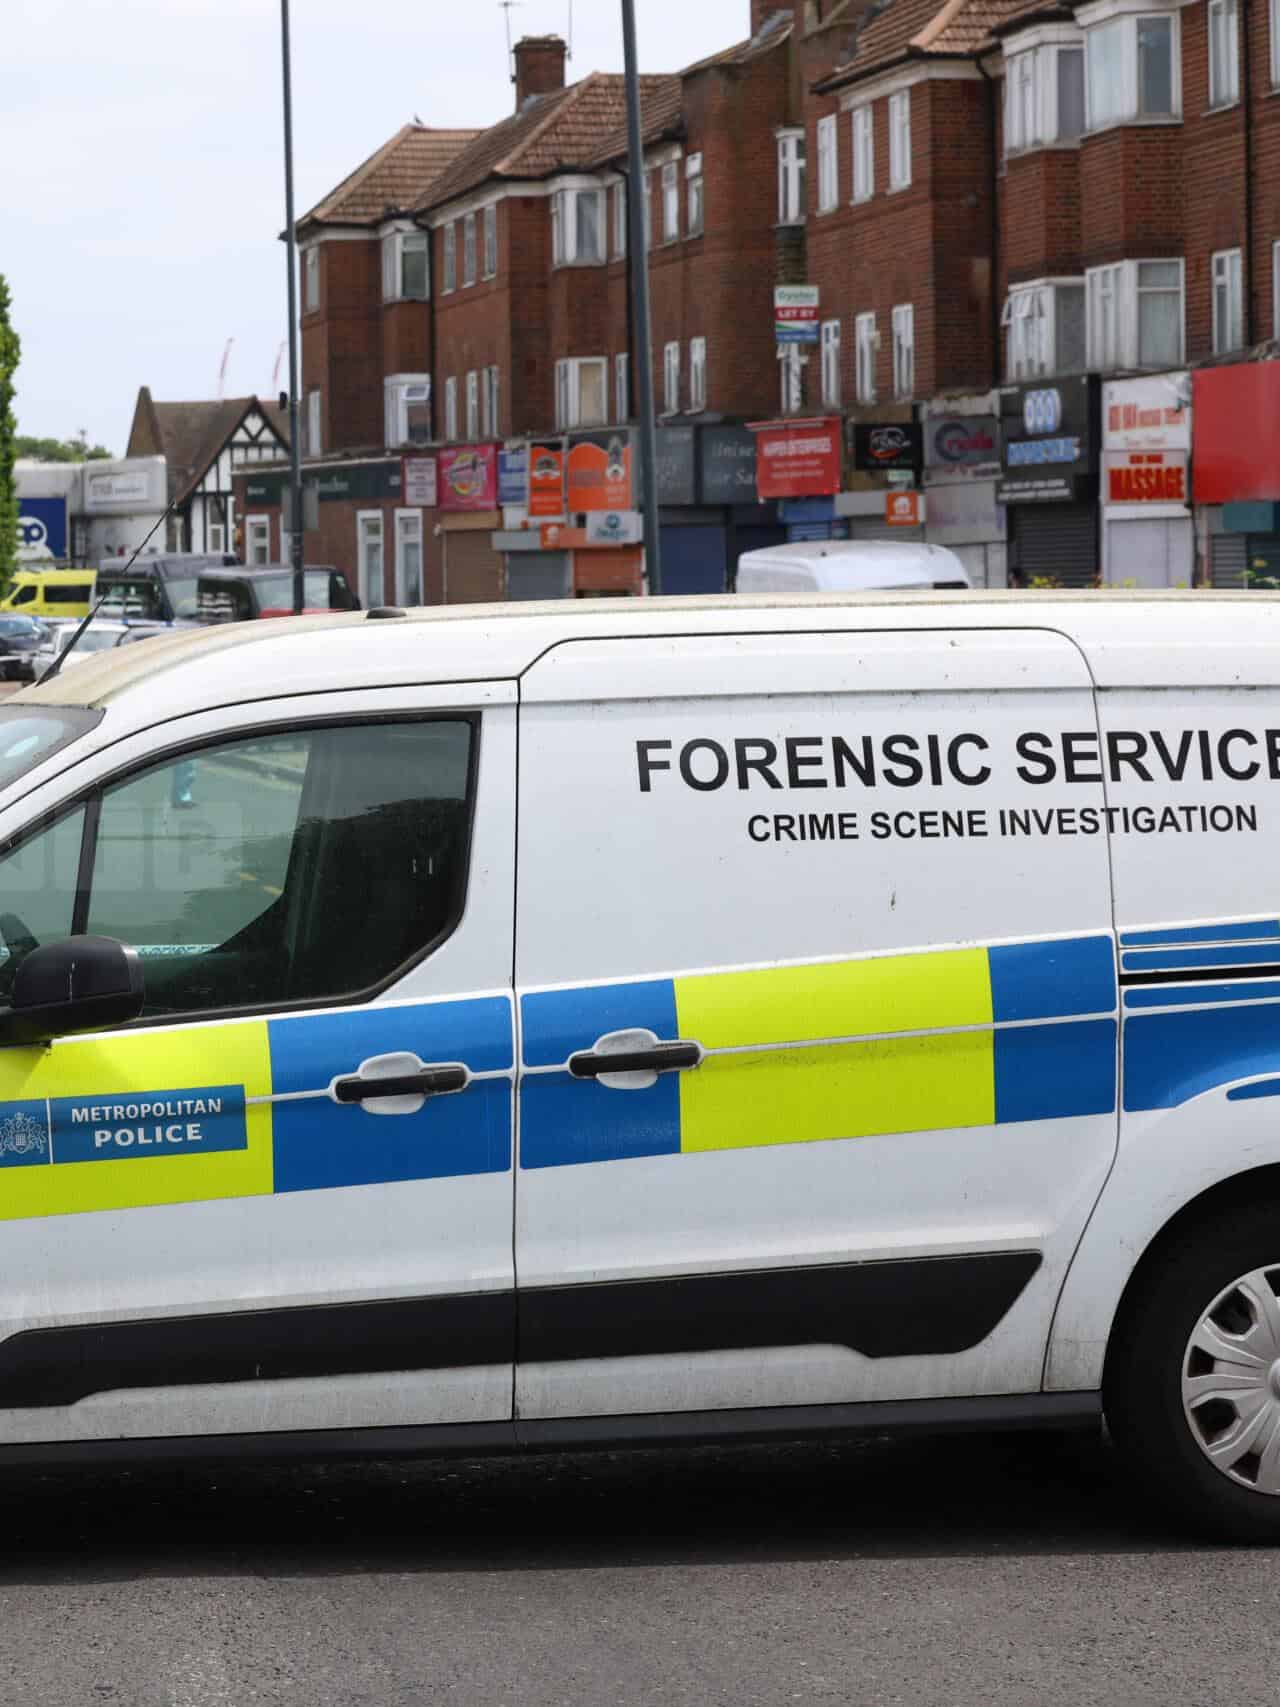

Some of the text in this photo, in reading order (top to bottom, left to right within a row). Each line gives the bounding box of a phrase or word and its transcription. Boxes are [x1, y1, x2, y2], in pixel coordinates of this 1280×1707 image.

[635, 732, 991, 793] FORENSIC
[748, 804, 1258, 842] CRIME SCENE INVESTIGATION
[71, 1098, 221, 1123] METROPOLITAN
[94, 1123, 202, 1148] POLICE
